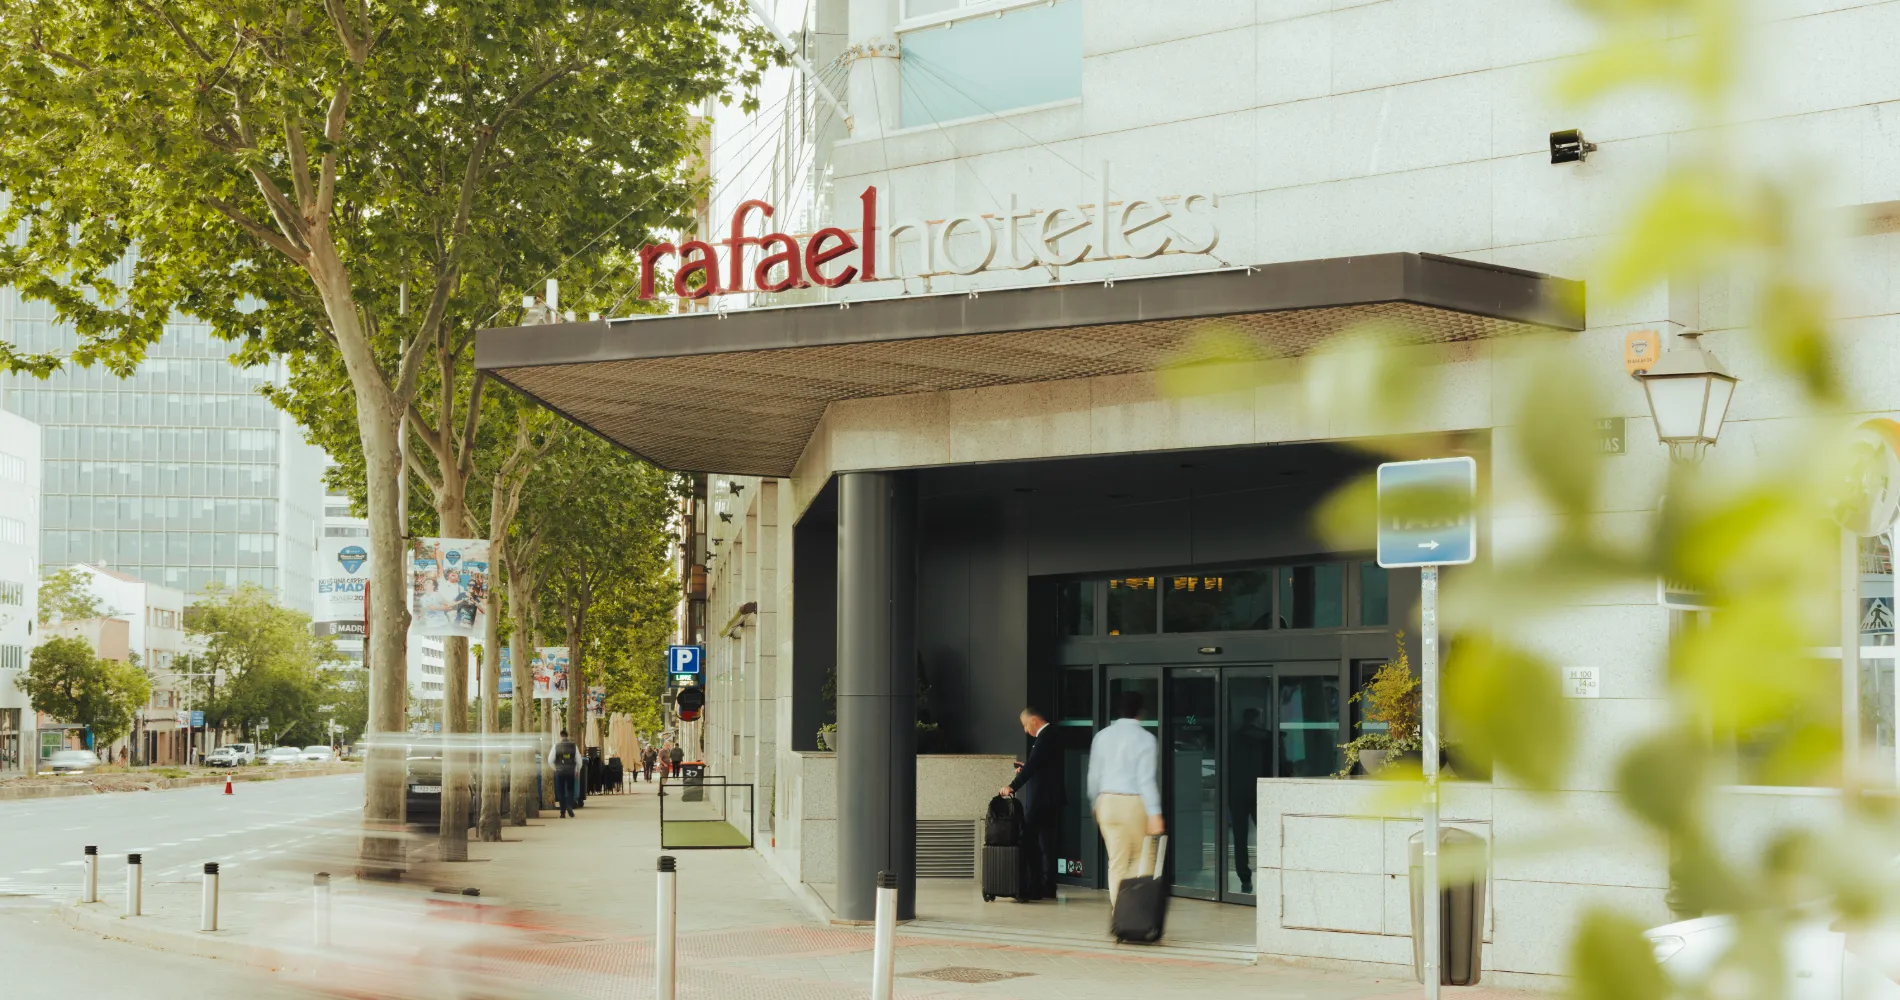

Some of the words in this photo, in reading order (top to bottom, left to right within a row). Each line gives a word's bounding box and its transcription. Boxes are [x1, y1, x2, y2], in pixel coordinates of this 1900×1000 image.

[335, 583, 365, 592] MAD
[338, 624, 366, 634] MADRI
[677, 649, 693, 672] P
[1570, 670, 1577, 678] H
[1580, 670, 1592, 678] 100
